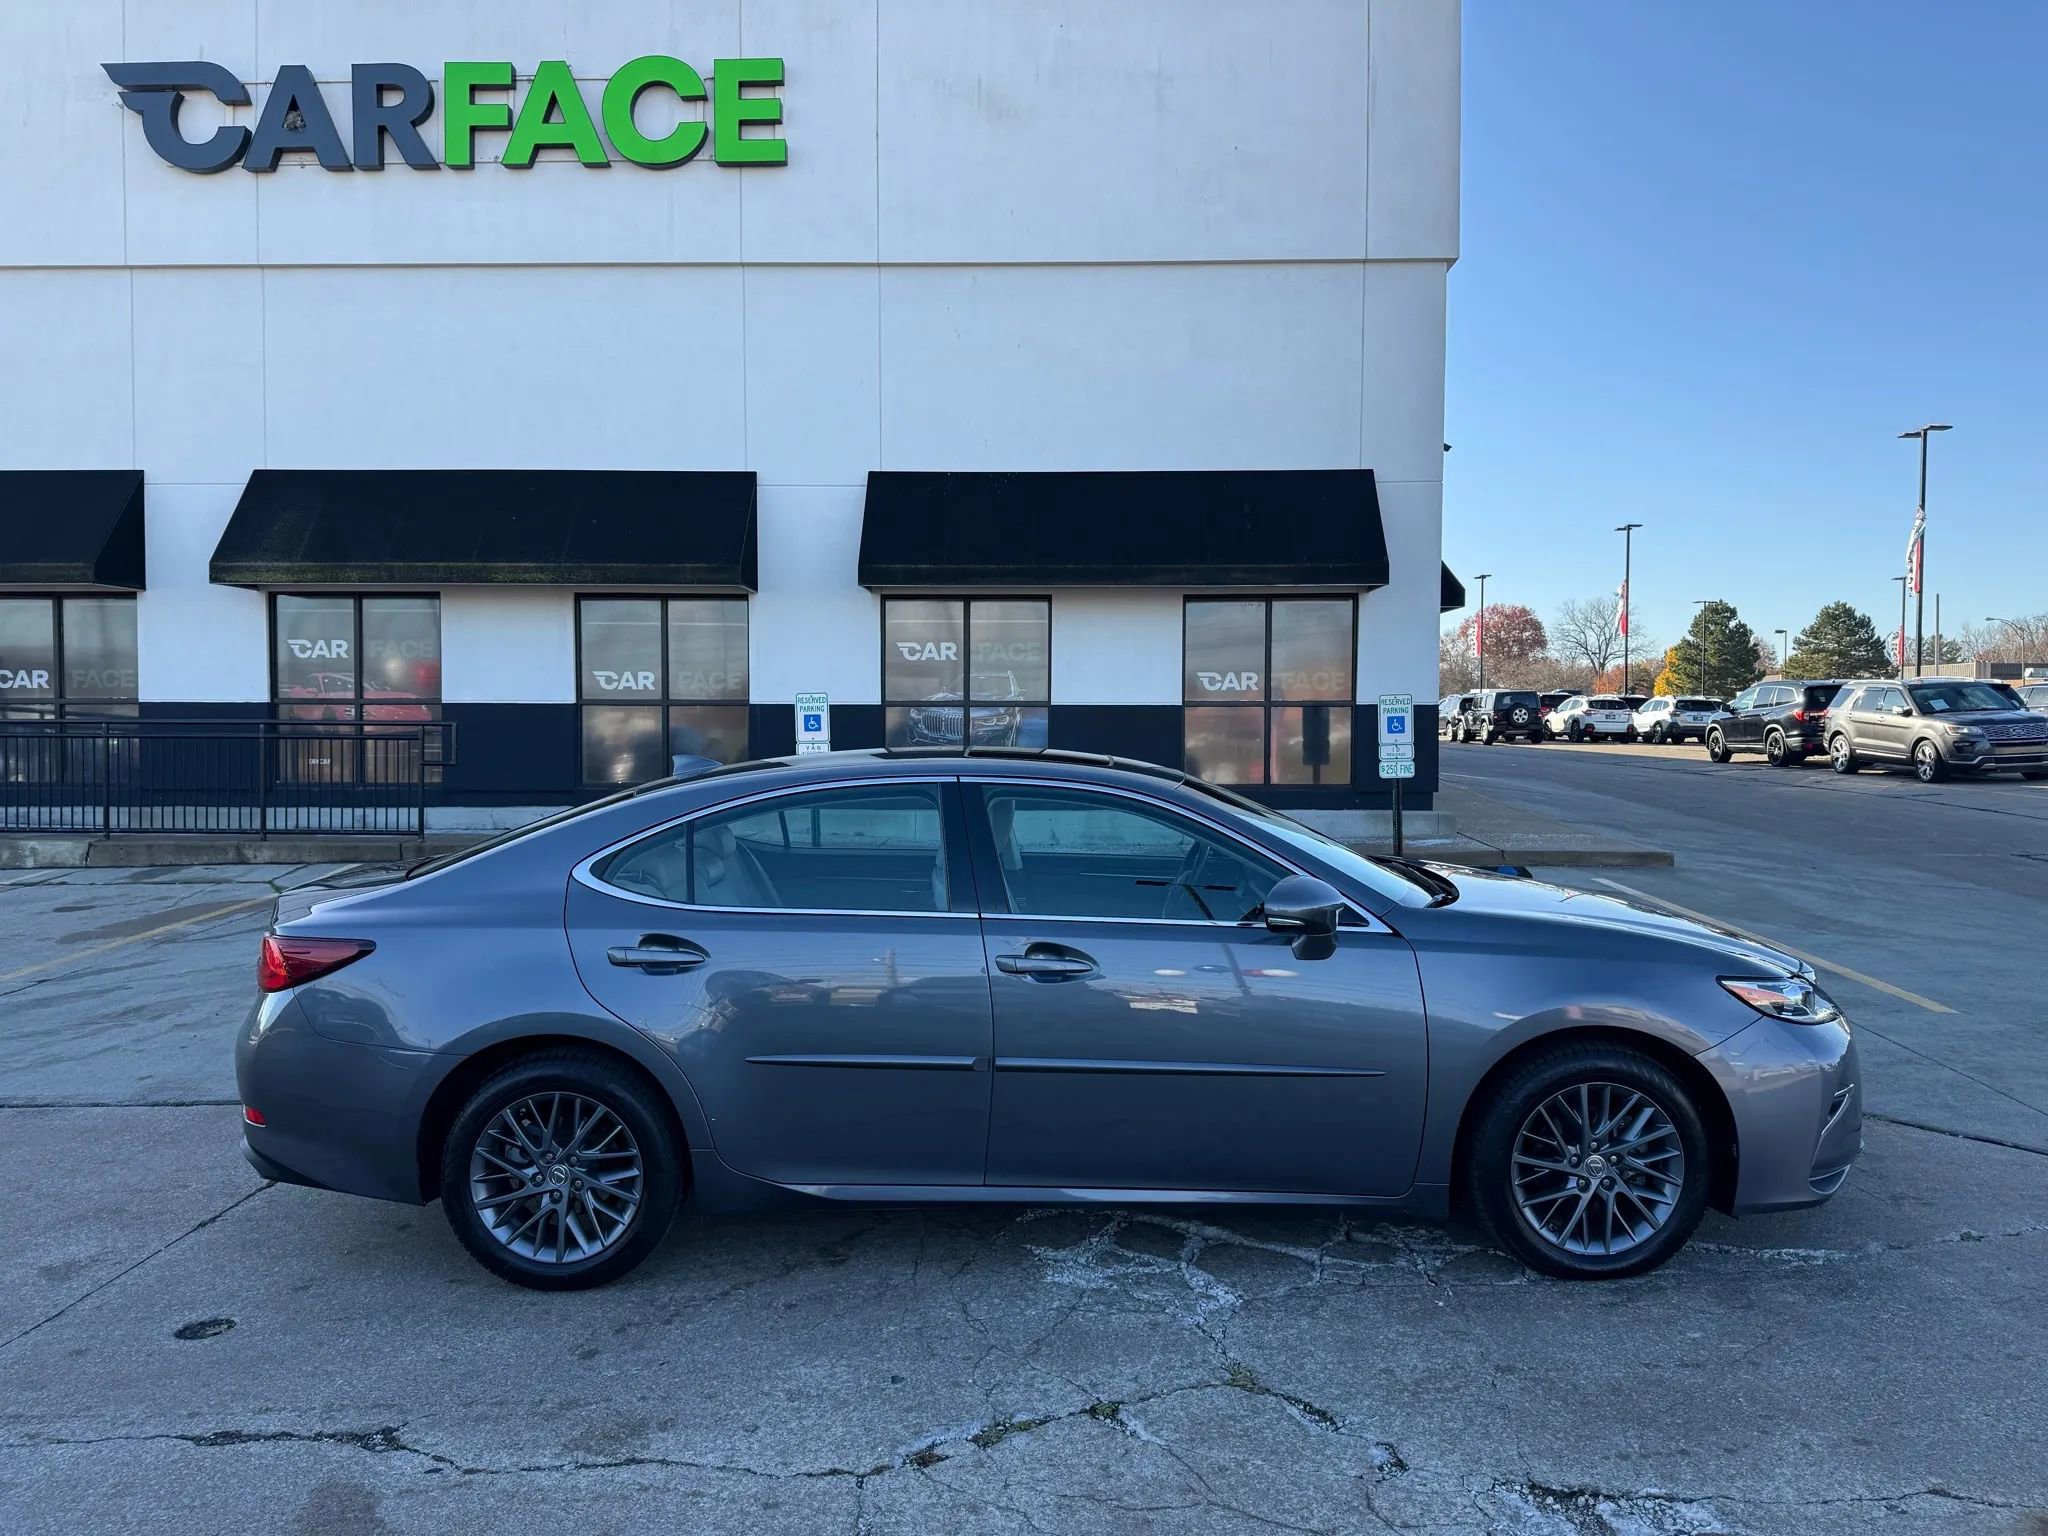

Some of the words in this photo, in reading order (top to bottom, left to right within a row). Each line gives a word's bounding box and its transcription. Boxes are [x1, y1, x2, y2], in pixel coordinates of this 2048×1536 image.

[100, 55, 788, 173] CARFACE
[287, 639, 349, 659] CAR
[369, 639, 434, 659] FACE
[896, 642, 958, 661] CAR
[977, 642, 1041, 661] FACE
[0, 669, 50, 689] CAR
[71, 669, 136, 688] FACE
[592, 671, 656, 690] CAR
[677, 671, 743, 690] FACE
[1196, 671, 1259, 691] CAR
[1279, 671, 1345, 691] FACE
[799, 705, 825, 713] PARKING
[1380, 698, 1411, 706] RESERVED
[1380, 764, 1398, 775] $250
[1400, 764, 1413, 774] FINE
